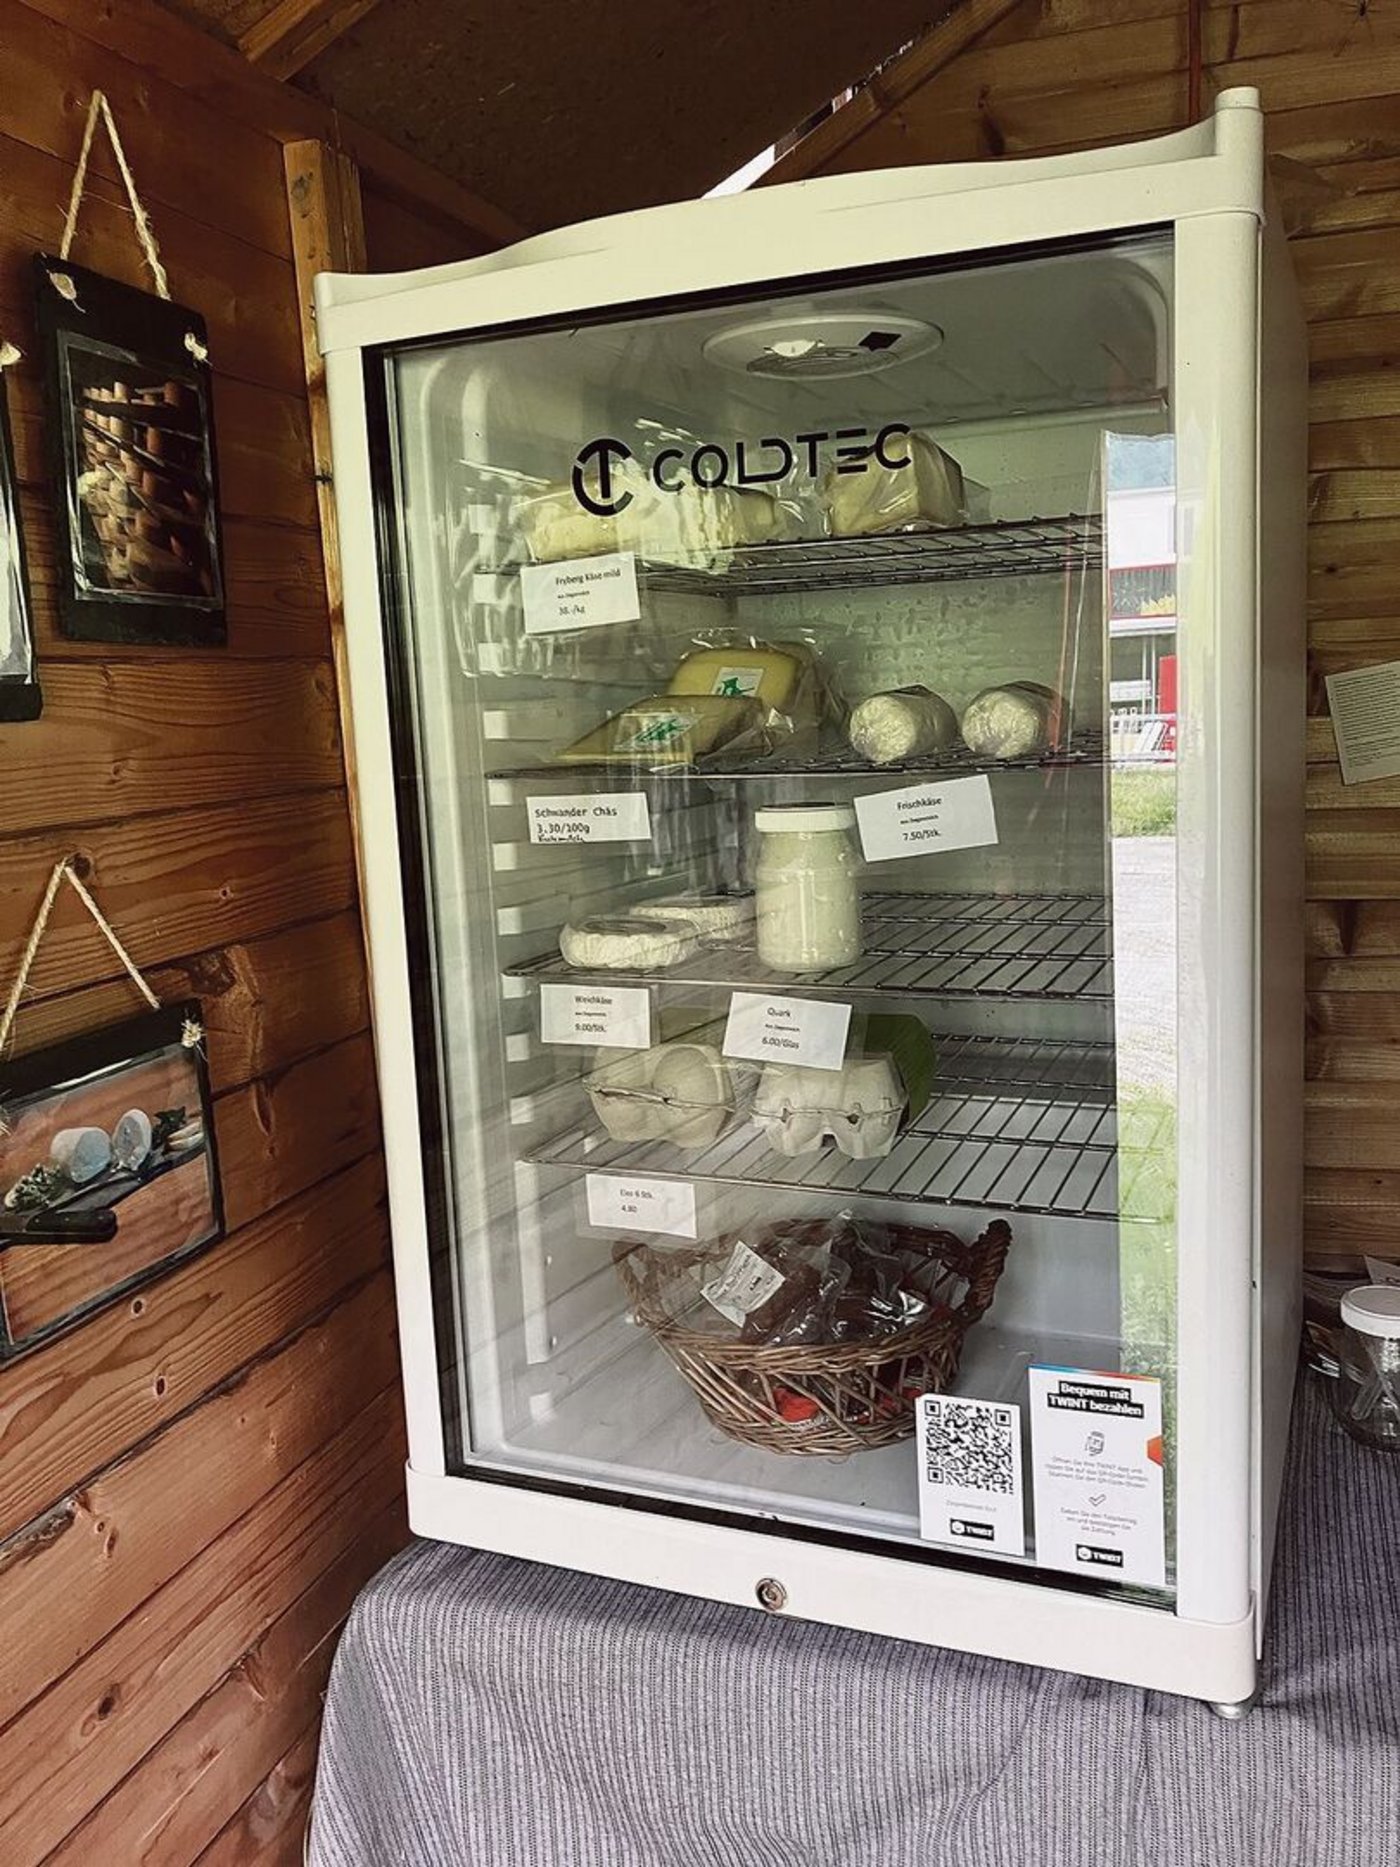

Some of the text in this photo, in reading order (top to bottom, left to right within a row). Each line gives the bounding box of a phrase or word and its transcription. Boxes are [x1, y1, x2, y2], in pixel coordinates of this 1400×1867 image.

[652, 423, 912, 492] COLDTEC
[896, 797, 942, 811] Frischkäse
[534, 807, 588, 818] Schwander
[766, 1007, 791, 1018] Quark
[1060, 1382, 1130, 1401] Bequem mit
[1048, 1394, 1142, 1415] TWINT bezahlen
